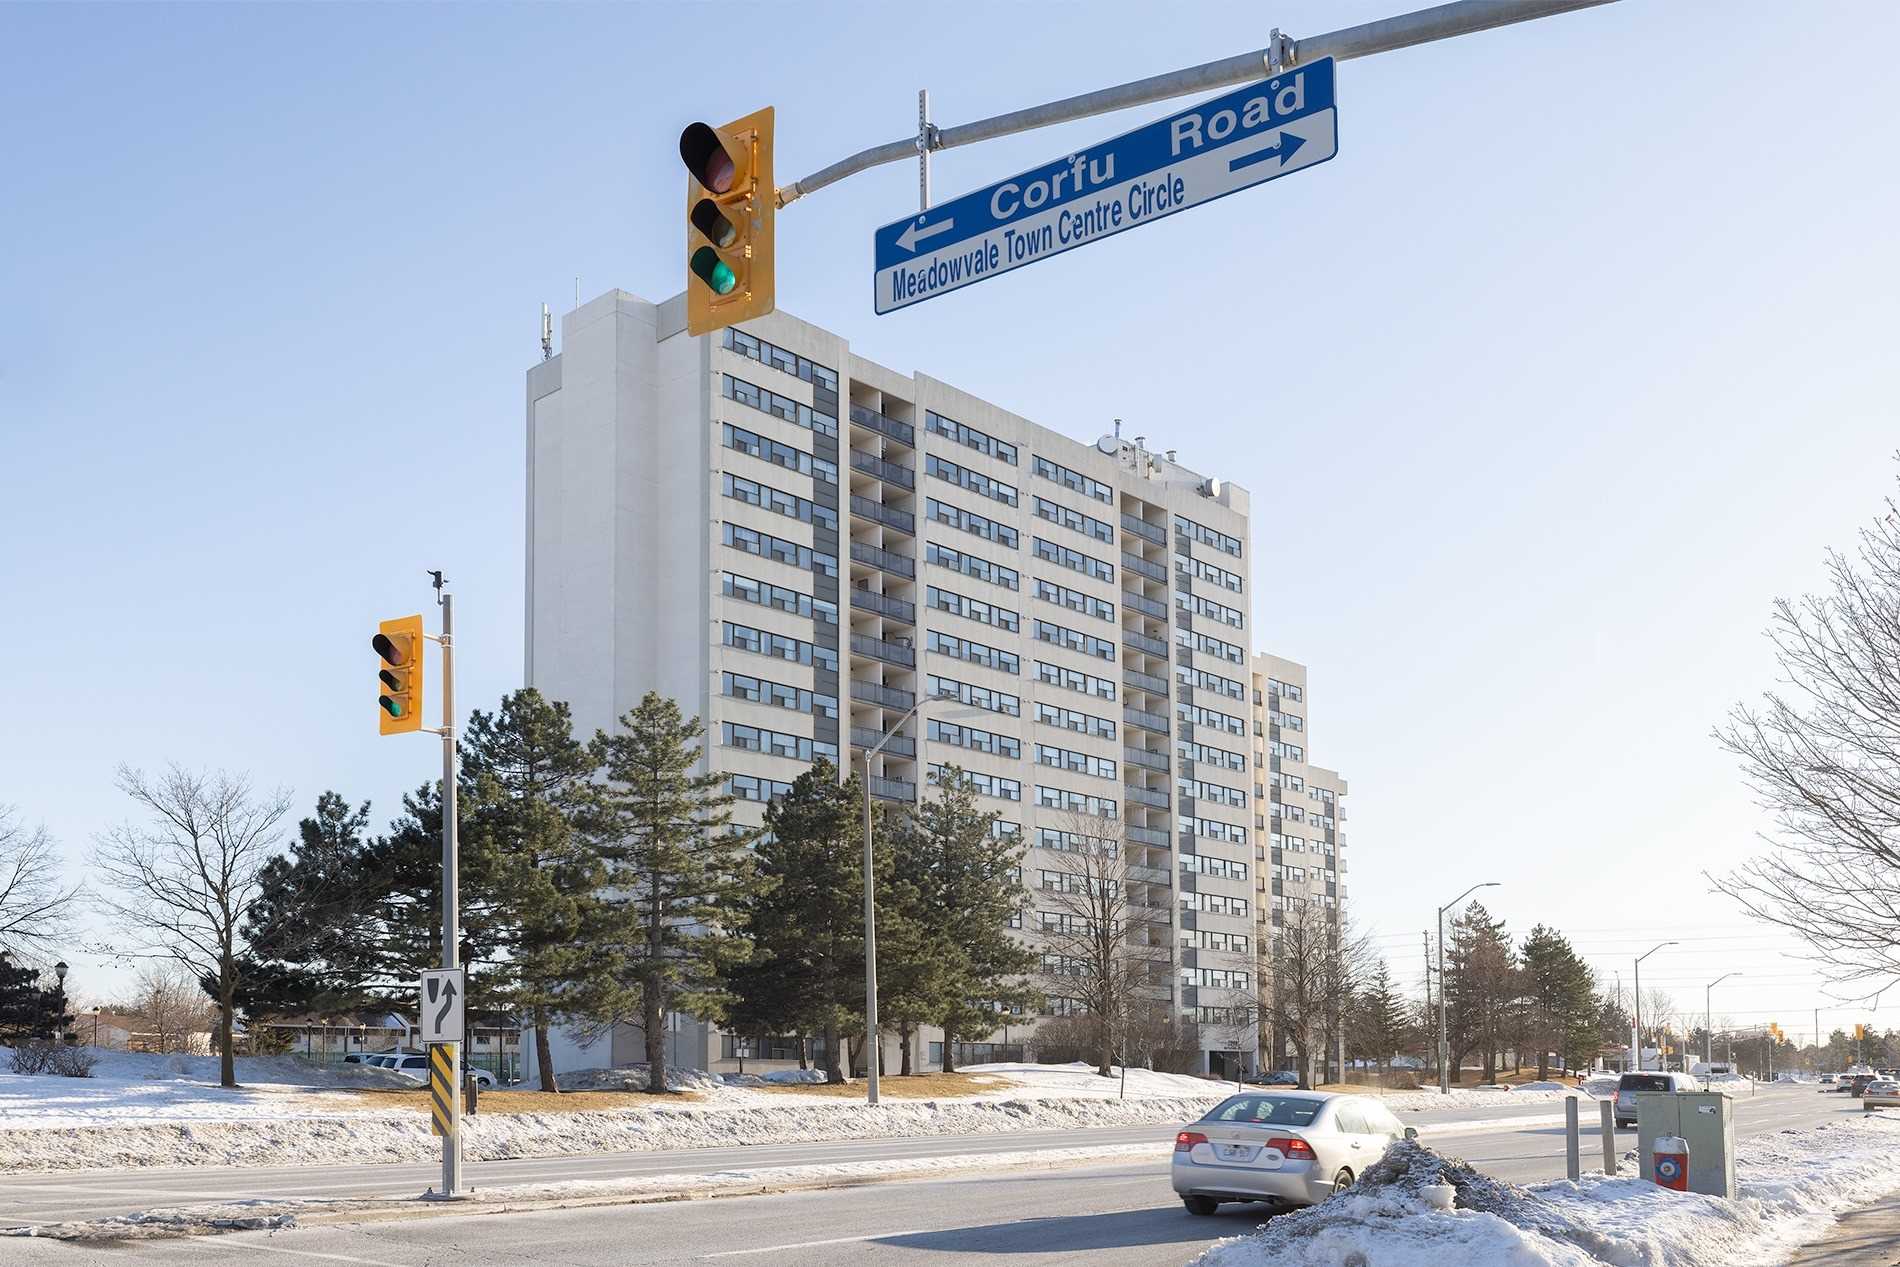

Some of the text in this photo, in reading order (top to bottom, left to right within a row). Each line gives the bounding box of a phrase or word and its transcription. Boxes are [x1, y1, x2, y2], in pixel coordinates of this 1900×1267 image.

[991, 72, 1305, 220] Corfu Road
[892, 173, 1184, 302] Meadowvale Town Centre Circle
